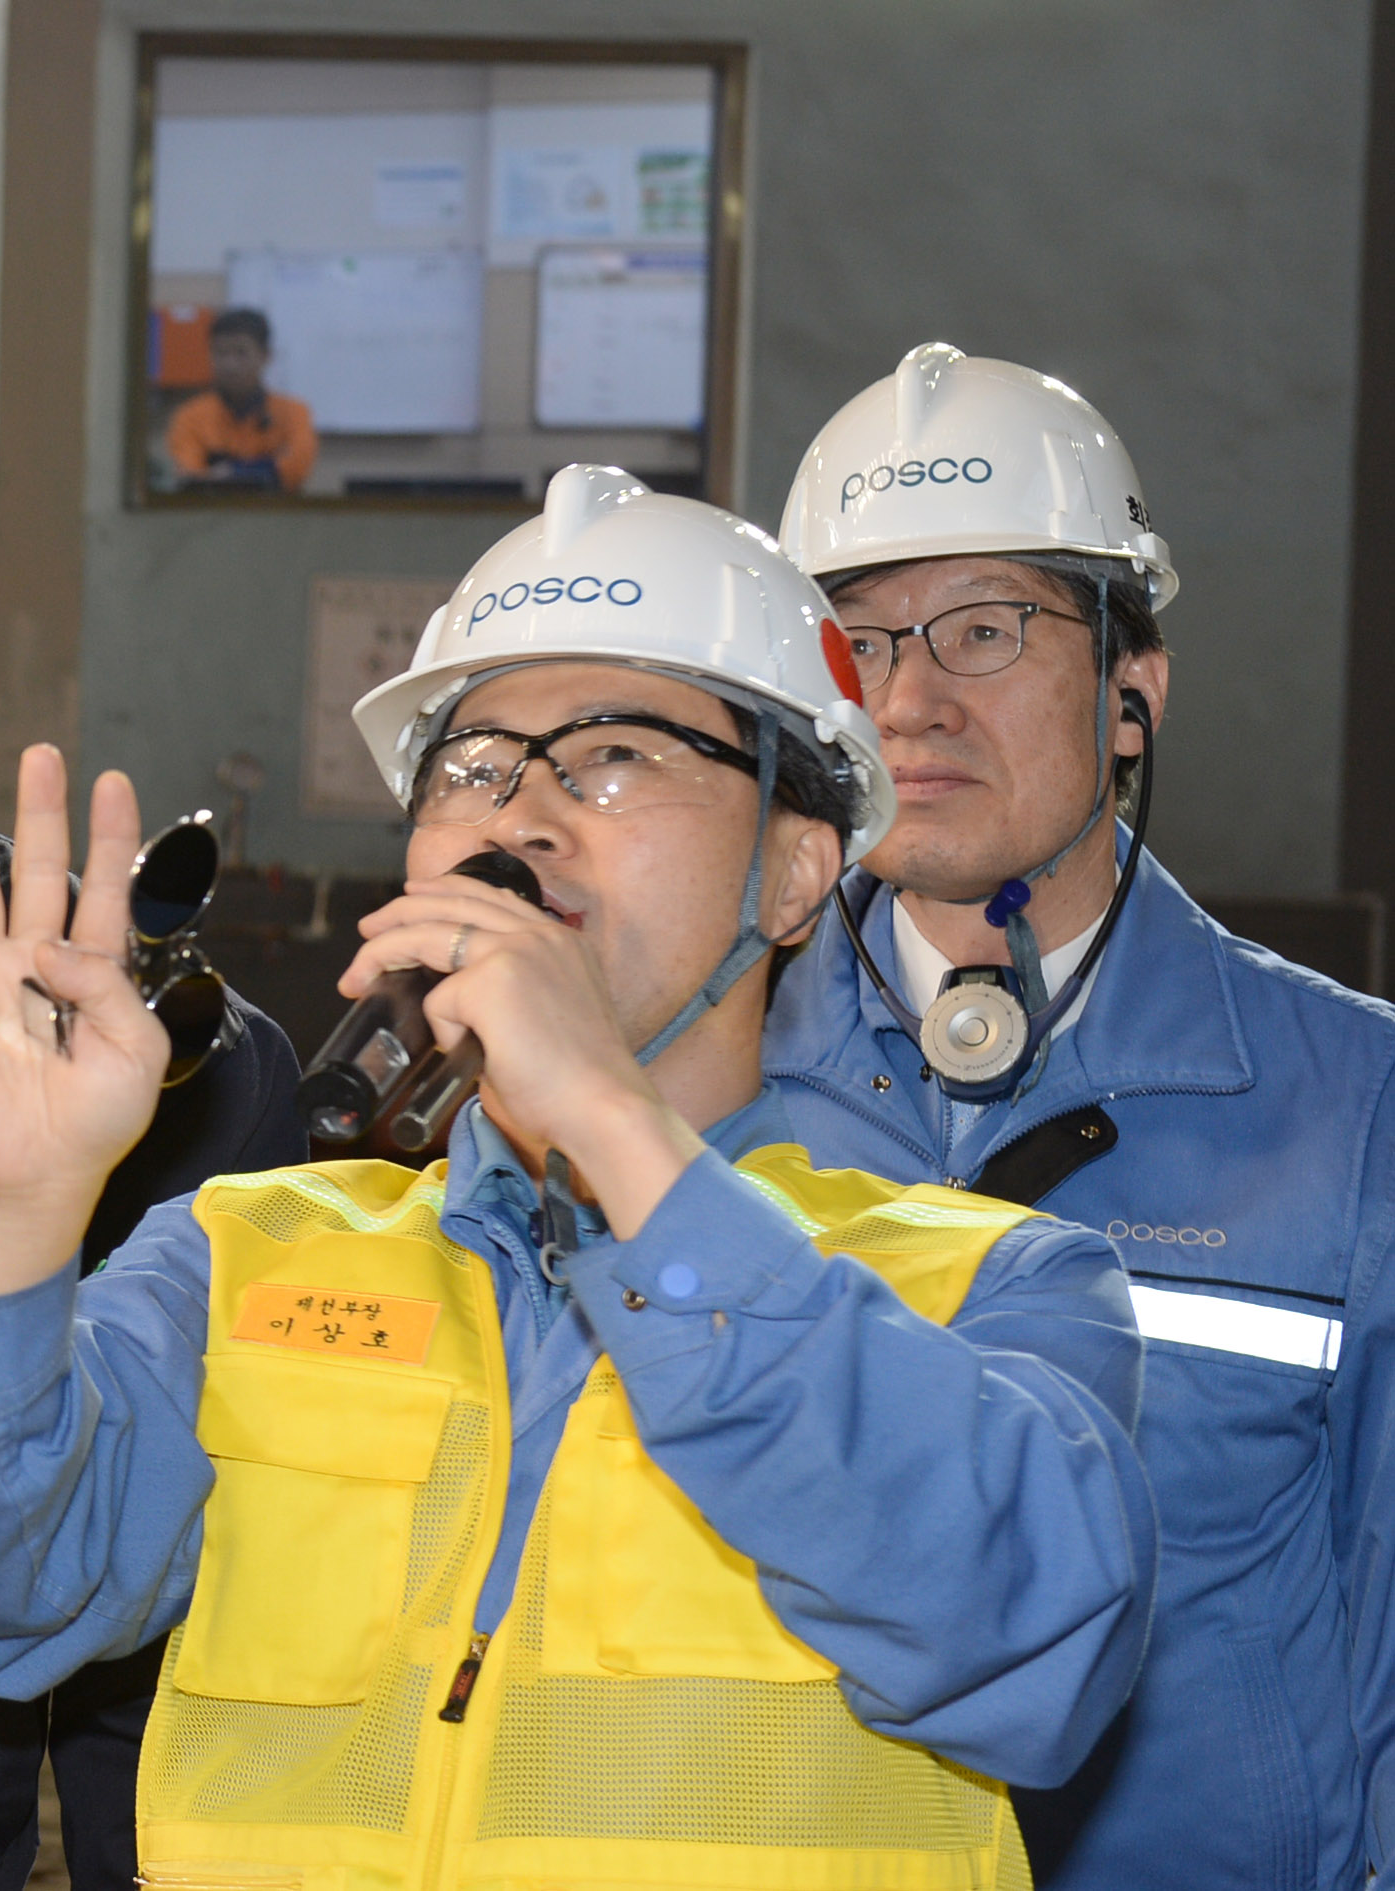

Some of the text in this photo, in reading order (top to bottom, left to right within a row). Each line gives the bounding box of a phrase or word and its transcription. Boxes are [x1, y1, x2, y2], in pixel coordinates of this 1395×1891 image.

[840, 457, 993, 513] posco
[465, 576, 642, 638] posco
[1107, 1219, 1227, 1248] posco
